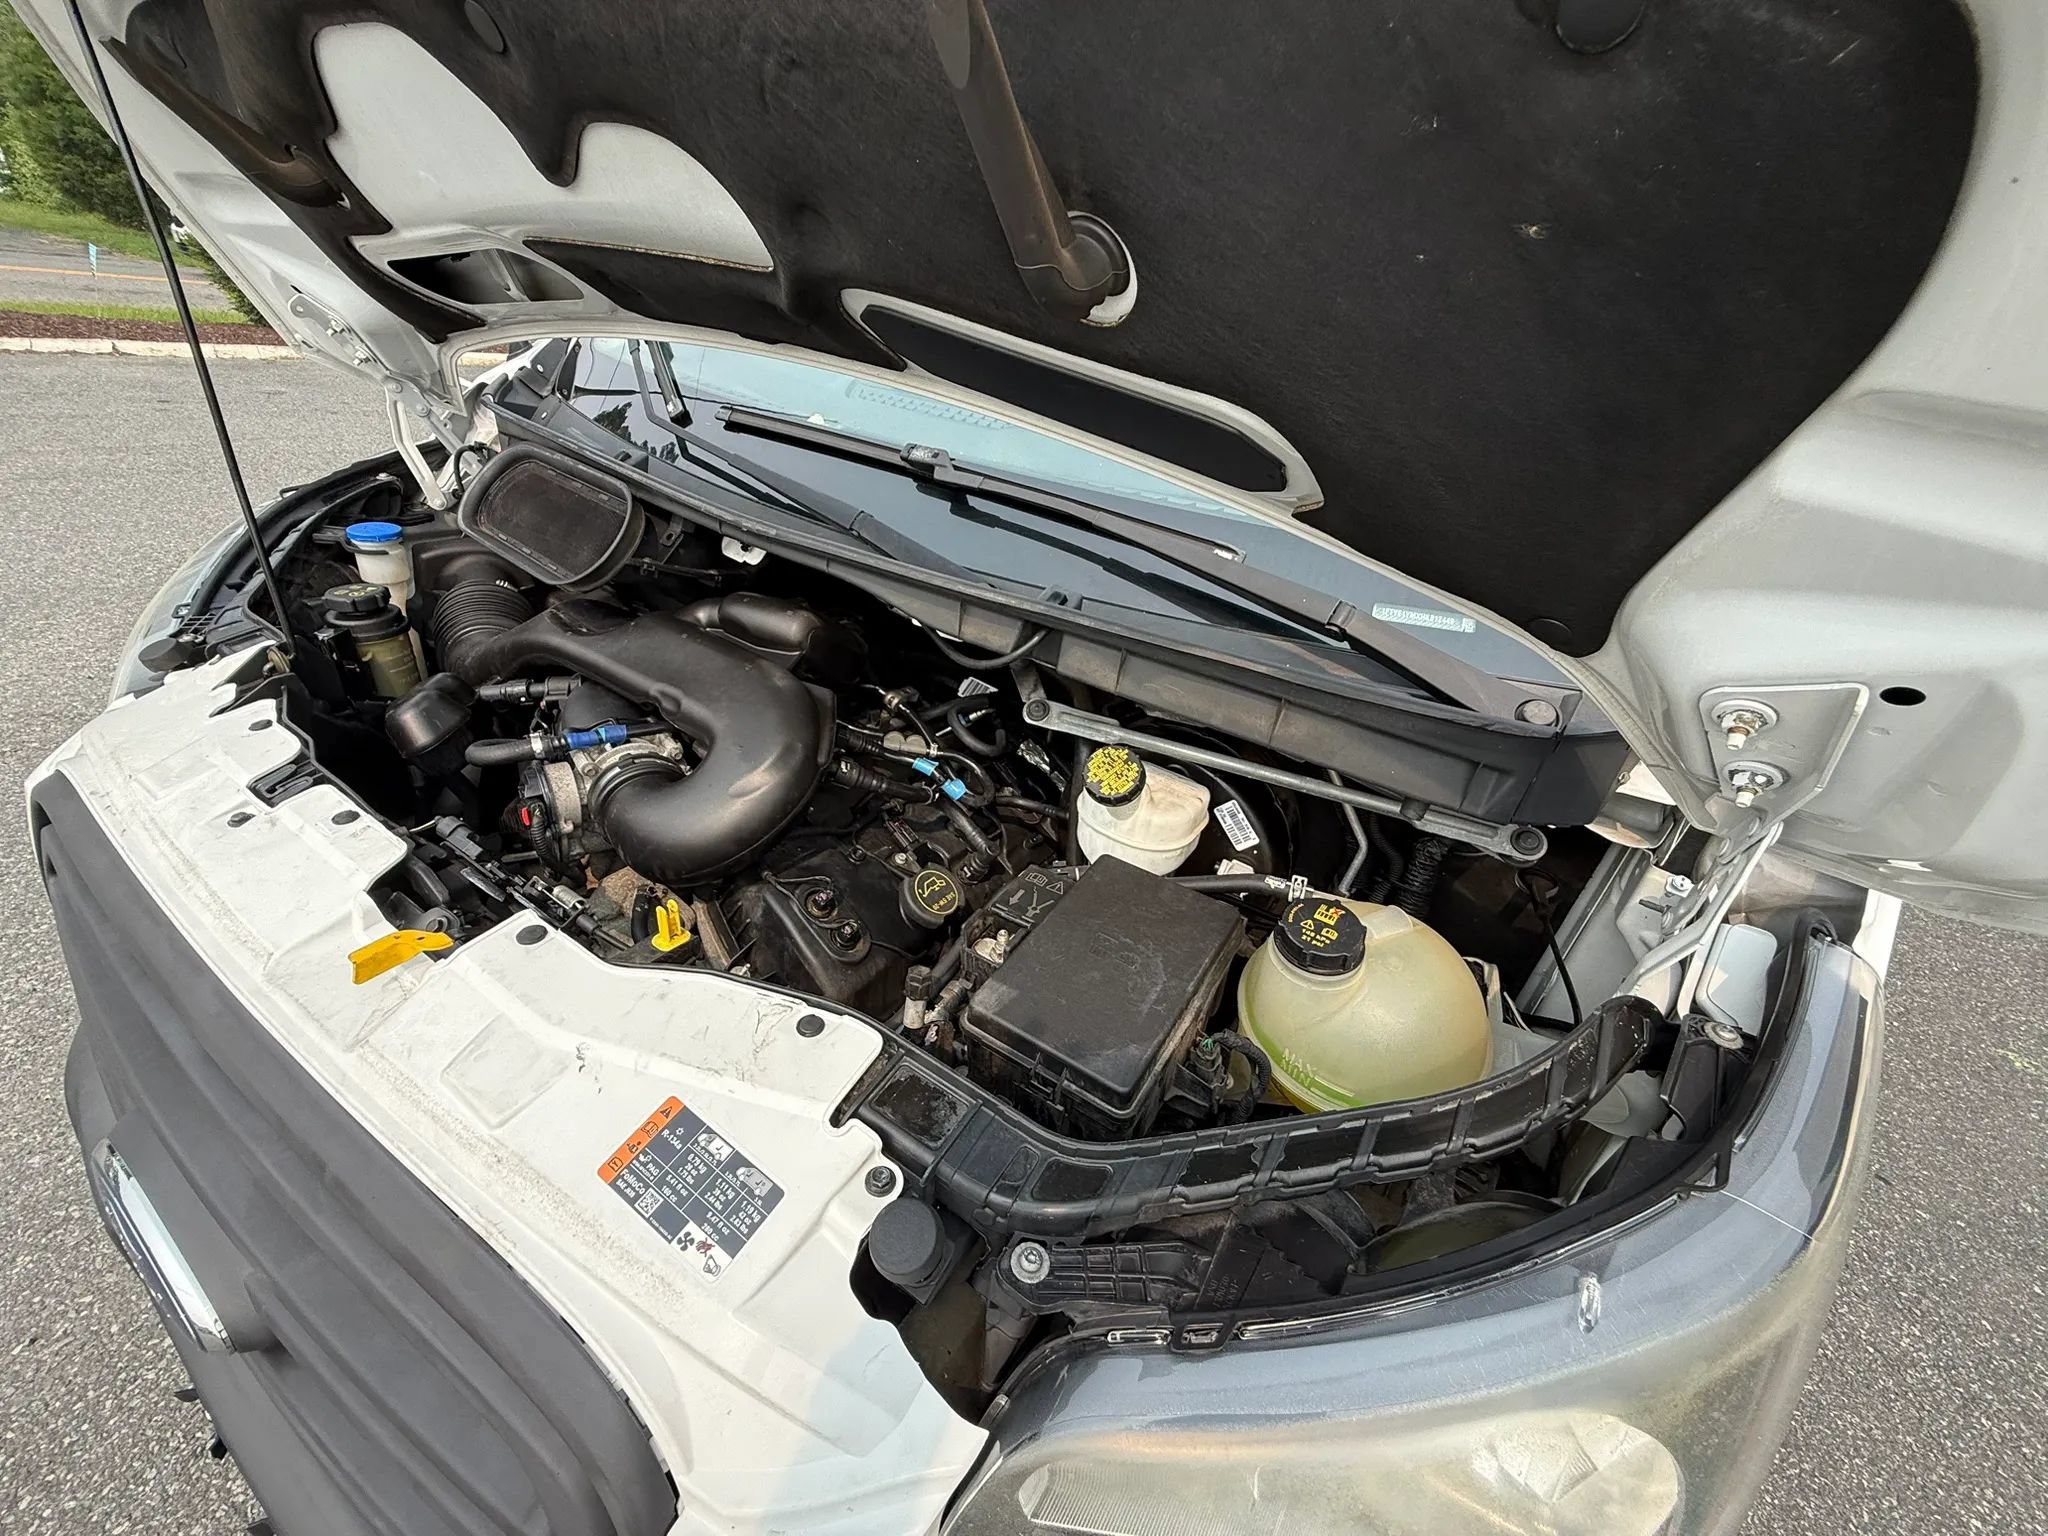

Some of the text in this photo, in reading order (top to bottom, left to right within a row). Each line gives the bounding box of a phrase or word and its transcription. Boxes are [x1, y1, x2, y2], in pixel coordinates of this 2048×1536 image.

[932, 897, 948, 910] 5W-20
[1280, 1059, 1310, 1086] MIN
[1282, 1048, 1317, 1078] MAX
[661, 1129, 682, 1149] R-134a
[646, 1163, 659, 1175] PAG
[687, 1153, 707, 1174] 0.79 kg
[616, 1178, 626, 1188] SAE
[620, 1168, 646, 1194] FoMoCo
[666, 1174, 677, 1185] 5.41
[680, 1188, 688, 1196] oz
[677, 1167, 694, 1184] 1.75 lbs
[715, 1178, 736, 1199] 1.11 kg
[704, 1192, 723, 1210] 2.44 lbs
[740, 1200, 761, 1222] 1.19 kg
[711, 1232, 719, 1241] cc
[721, 1226, 729, 1234] oz
[739, 1223, 749, 1233] lbs
